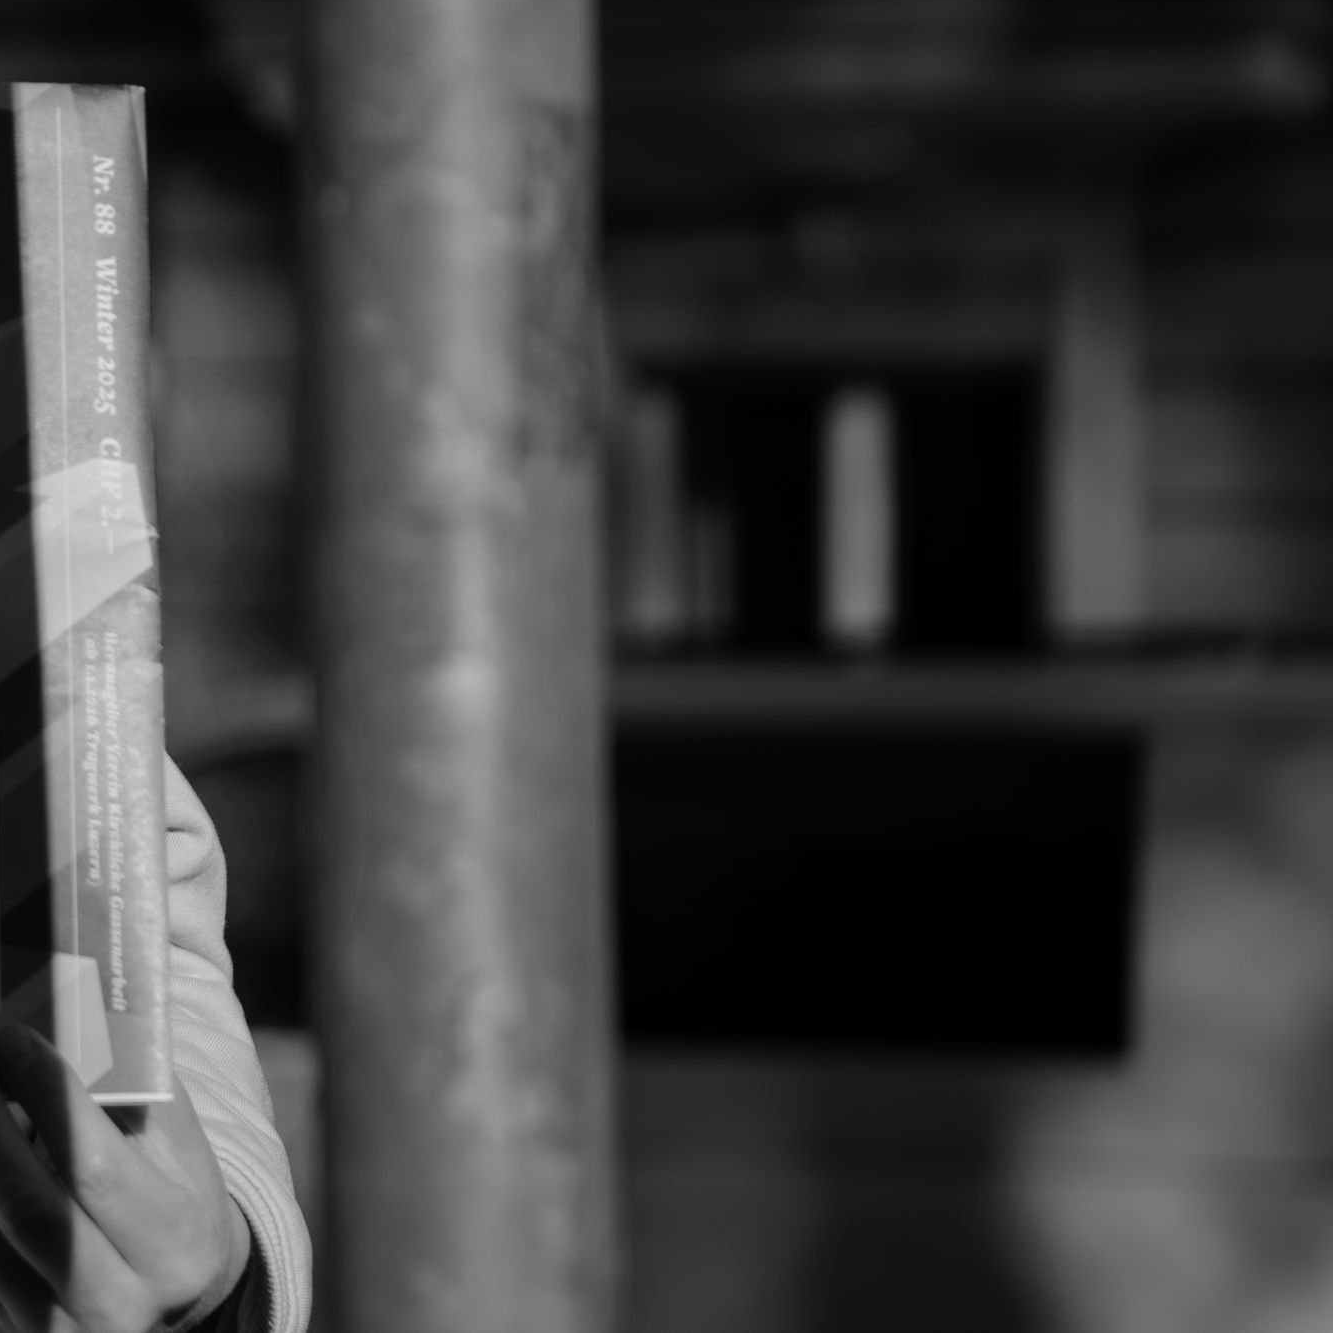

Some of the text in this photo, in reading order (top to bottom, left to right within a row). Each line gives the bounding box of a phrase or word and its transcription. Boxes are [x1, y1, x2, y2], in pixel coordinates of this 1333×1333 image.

[92, 155, 115, 195] Nr.
[93, 202, 117, 235] 88
[94, 256, 120, 352] Winter
[92, 357, 116, 416] 2025
[106, 802, 126, 892] Kirchliche
[109, 895, 130, 1012] Gassenarbeit
